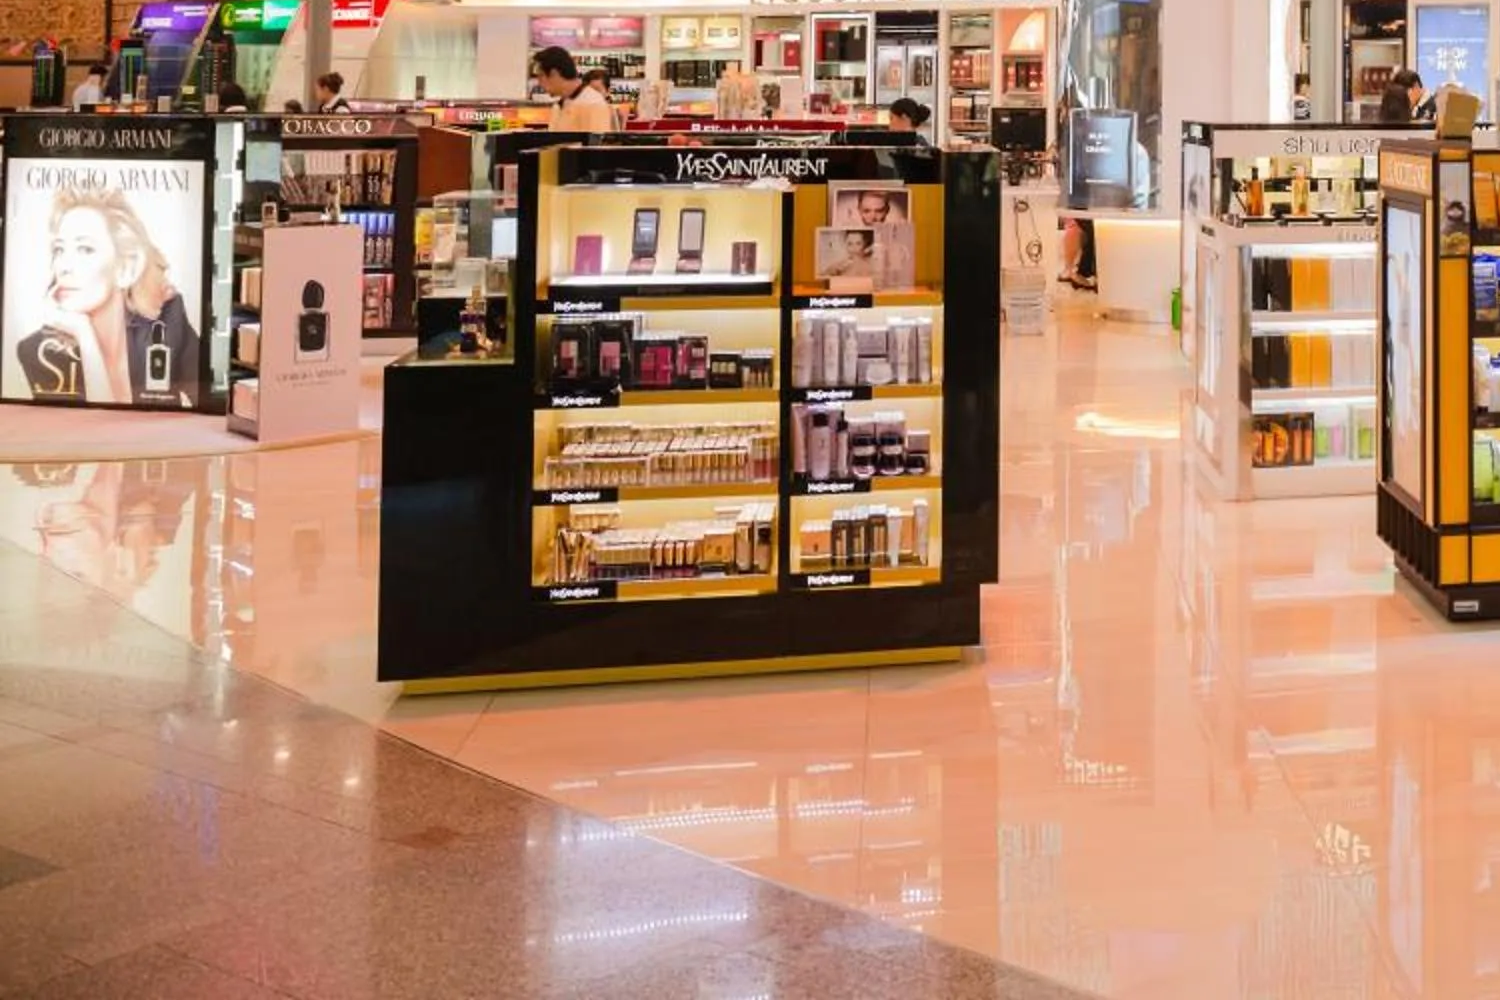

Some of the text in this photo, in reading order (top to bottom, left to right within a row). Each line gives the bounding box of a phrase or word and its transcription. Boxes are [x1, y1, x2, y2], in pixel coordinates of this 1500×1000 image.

[39, 126, 173, 149] GIORGIO ARMANI
[281, 117, 372, 136] OBACCO
[27, 166, 190, 193] GIORGIO ARMANI
